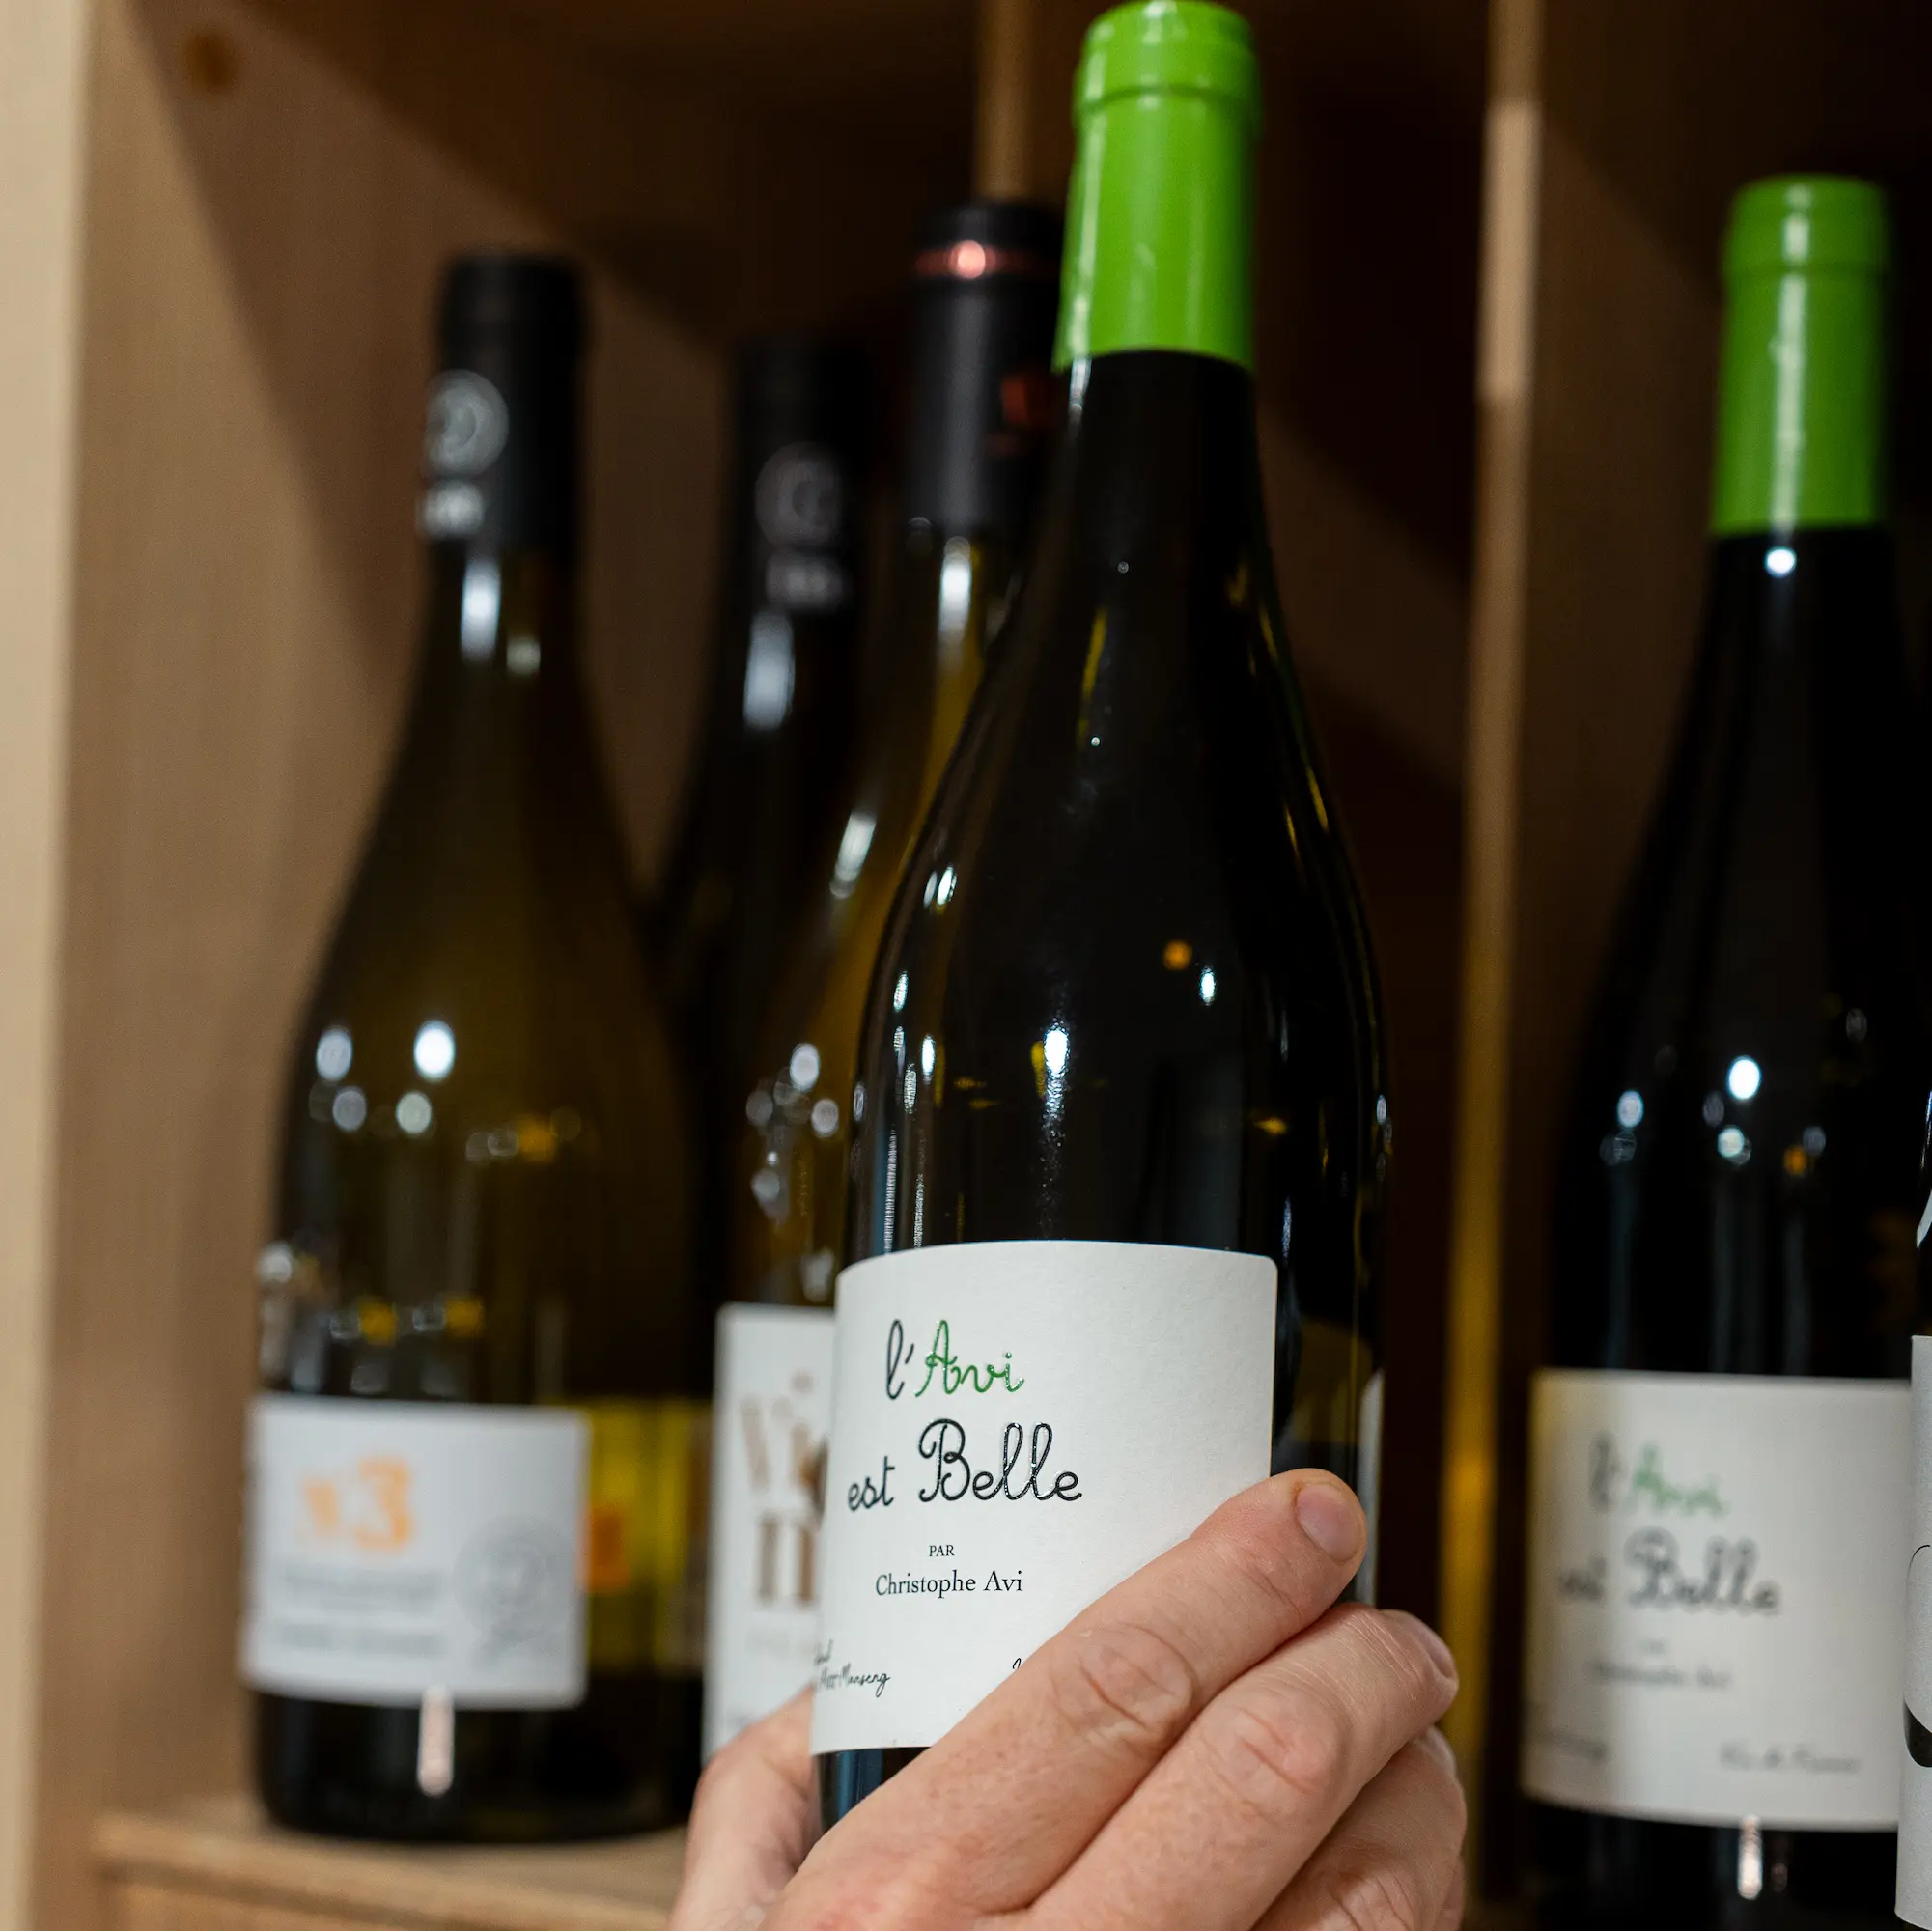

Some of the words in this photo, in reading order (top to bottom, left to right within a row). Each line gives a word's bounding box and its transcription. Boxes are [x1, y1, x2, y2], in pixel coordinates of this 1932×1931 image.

[885, 1318, 1025, 1401] l'Avi
[847, 1455, 896, 1512] est
[918, 1417, 1083, 1502] Belle
[928, 1544, 956, 1557] PAR
[875, 1568, 977, 1599] Christophe
[983, 1569, 1023, 1592] Avi
